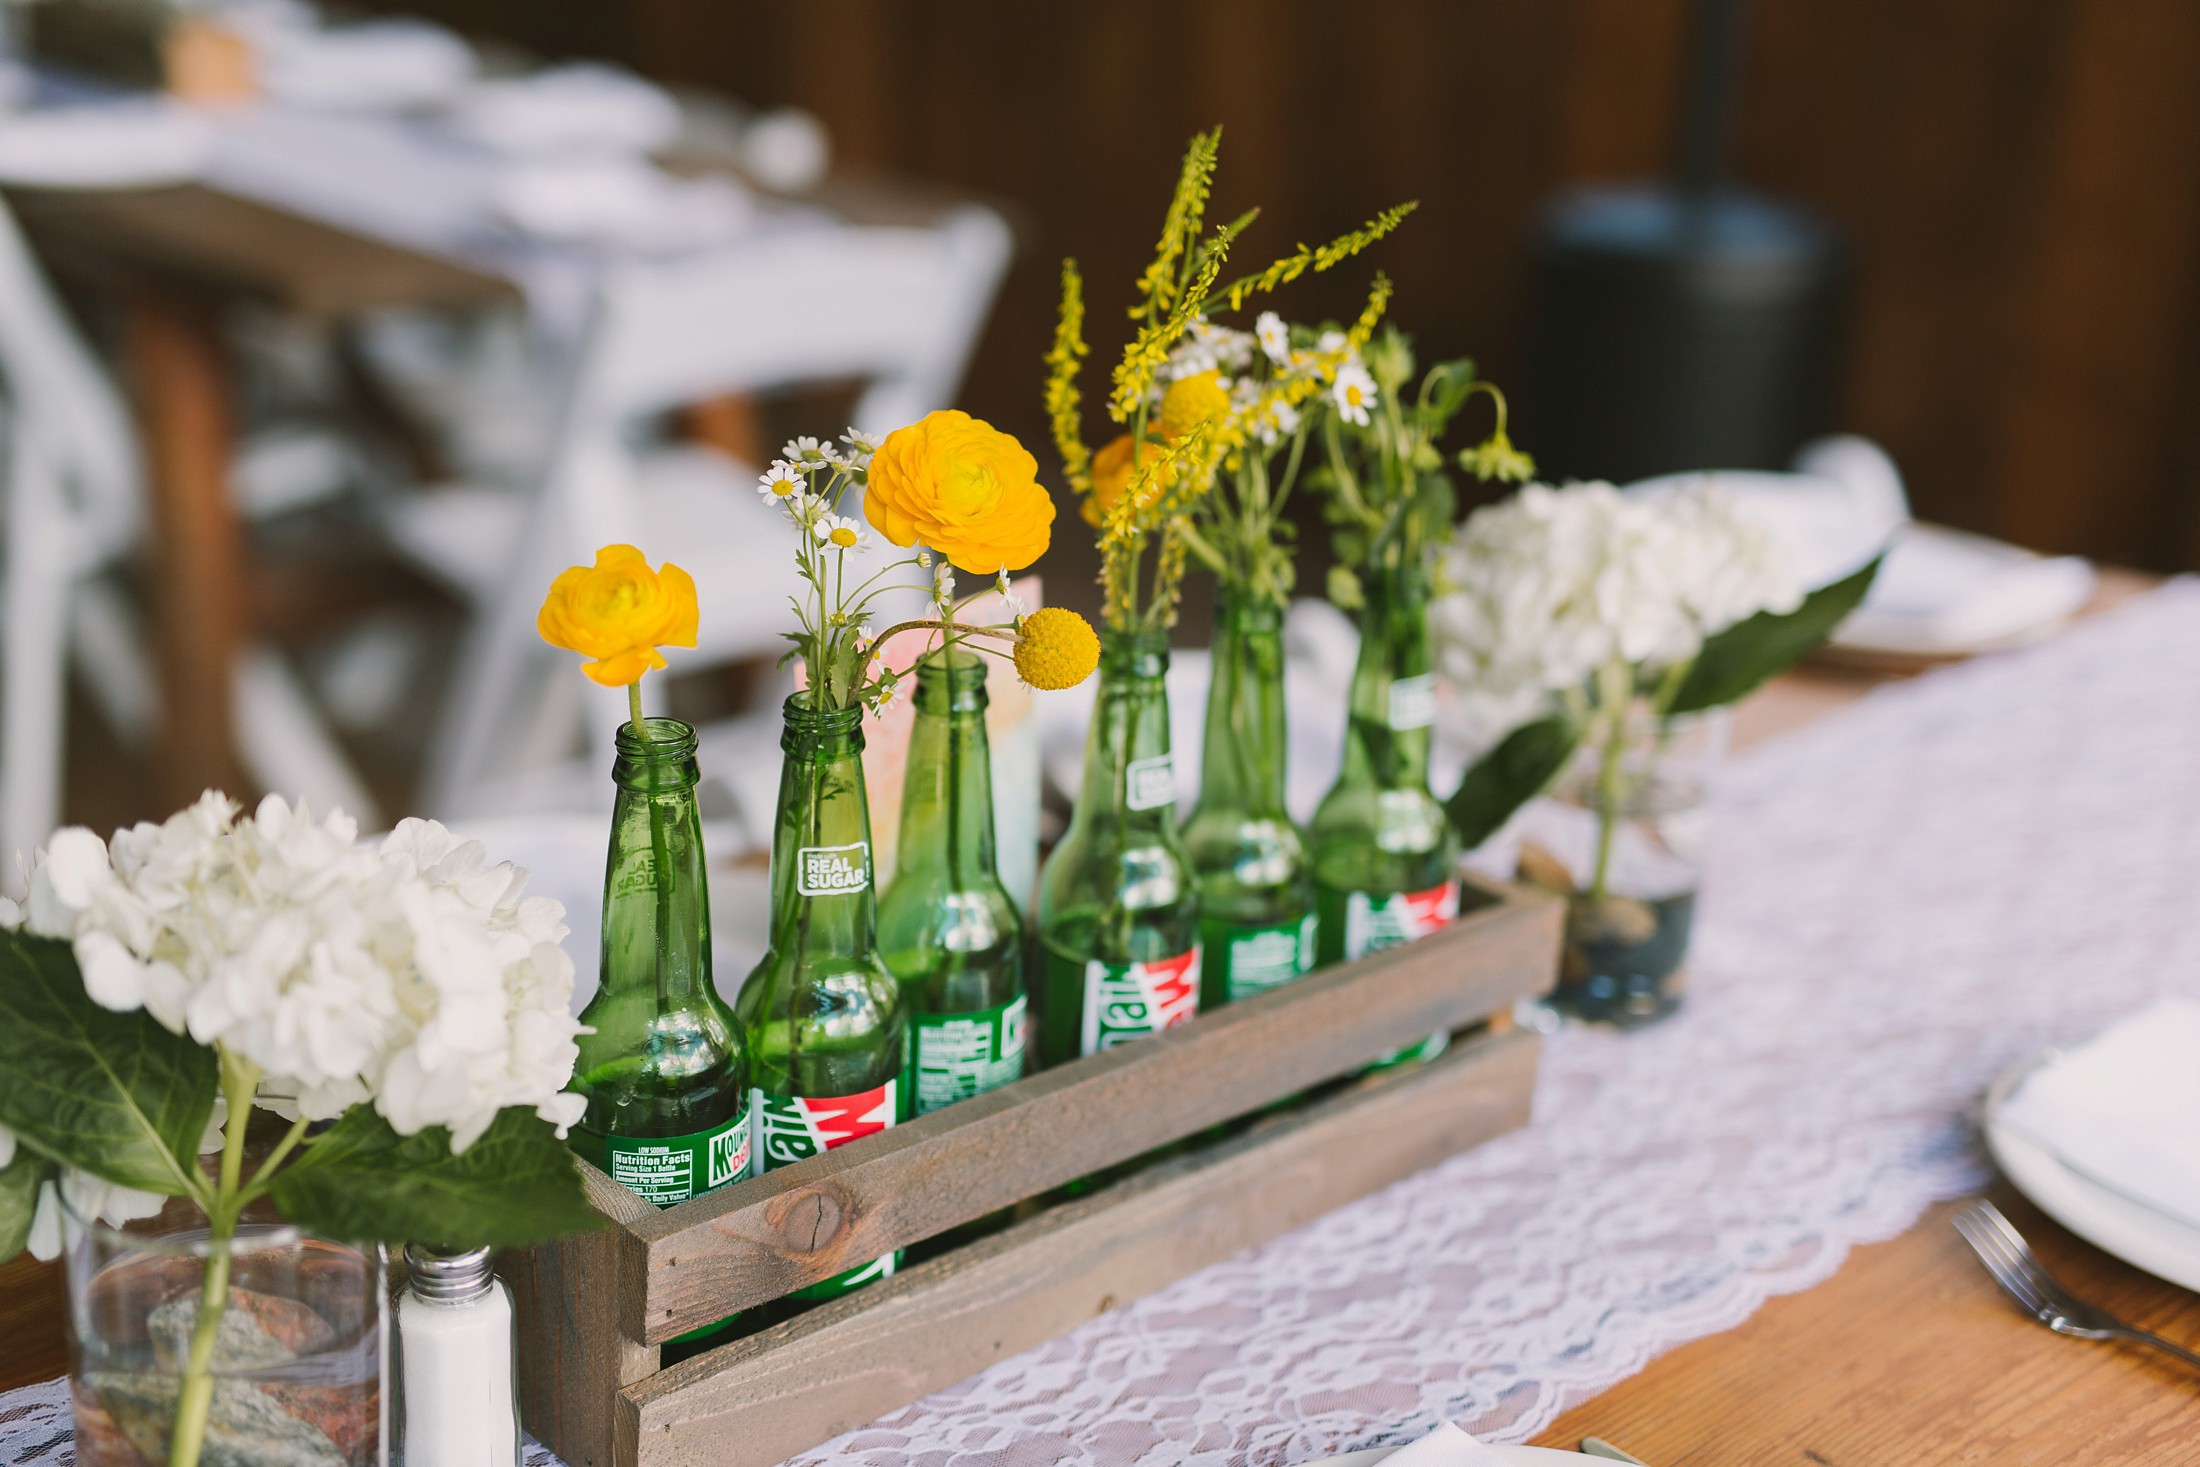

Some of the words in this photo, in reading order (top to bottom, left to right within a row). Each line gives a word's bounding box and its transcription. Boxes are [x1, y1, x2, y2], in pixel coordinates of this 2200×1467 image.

[807, 857, 853, 874] REAL
[807, 868, 865, 889] SUGAR
[638, 1146, 650, 1154] LOW
[650, 1146, 670, 1154] SODIUM
[615, 1154, 660, 1166] Nutrition
[662, 1154, 690, 1165] Facts
[615, 1163, 638, 1173] Serving
[639, 1165, 652, 1173] Size
[615, 1175, 638, 1184] Amount
[651, 1176, 674, 1184] Serving
[653, 1195, 668, 1203] Daily
